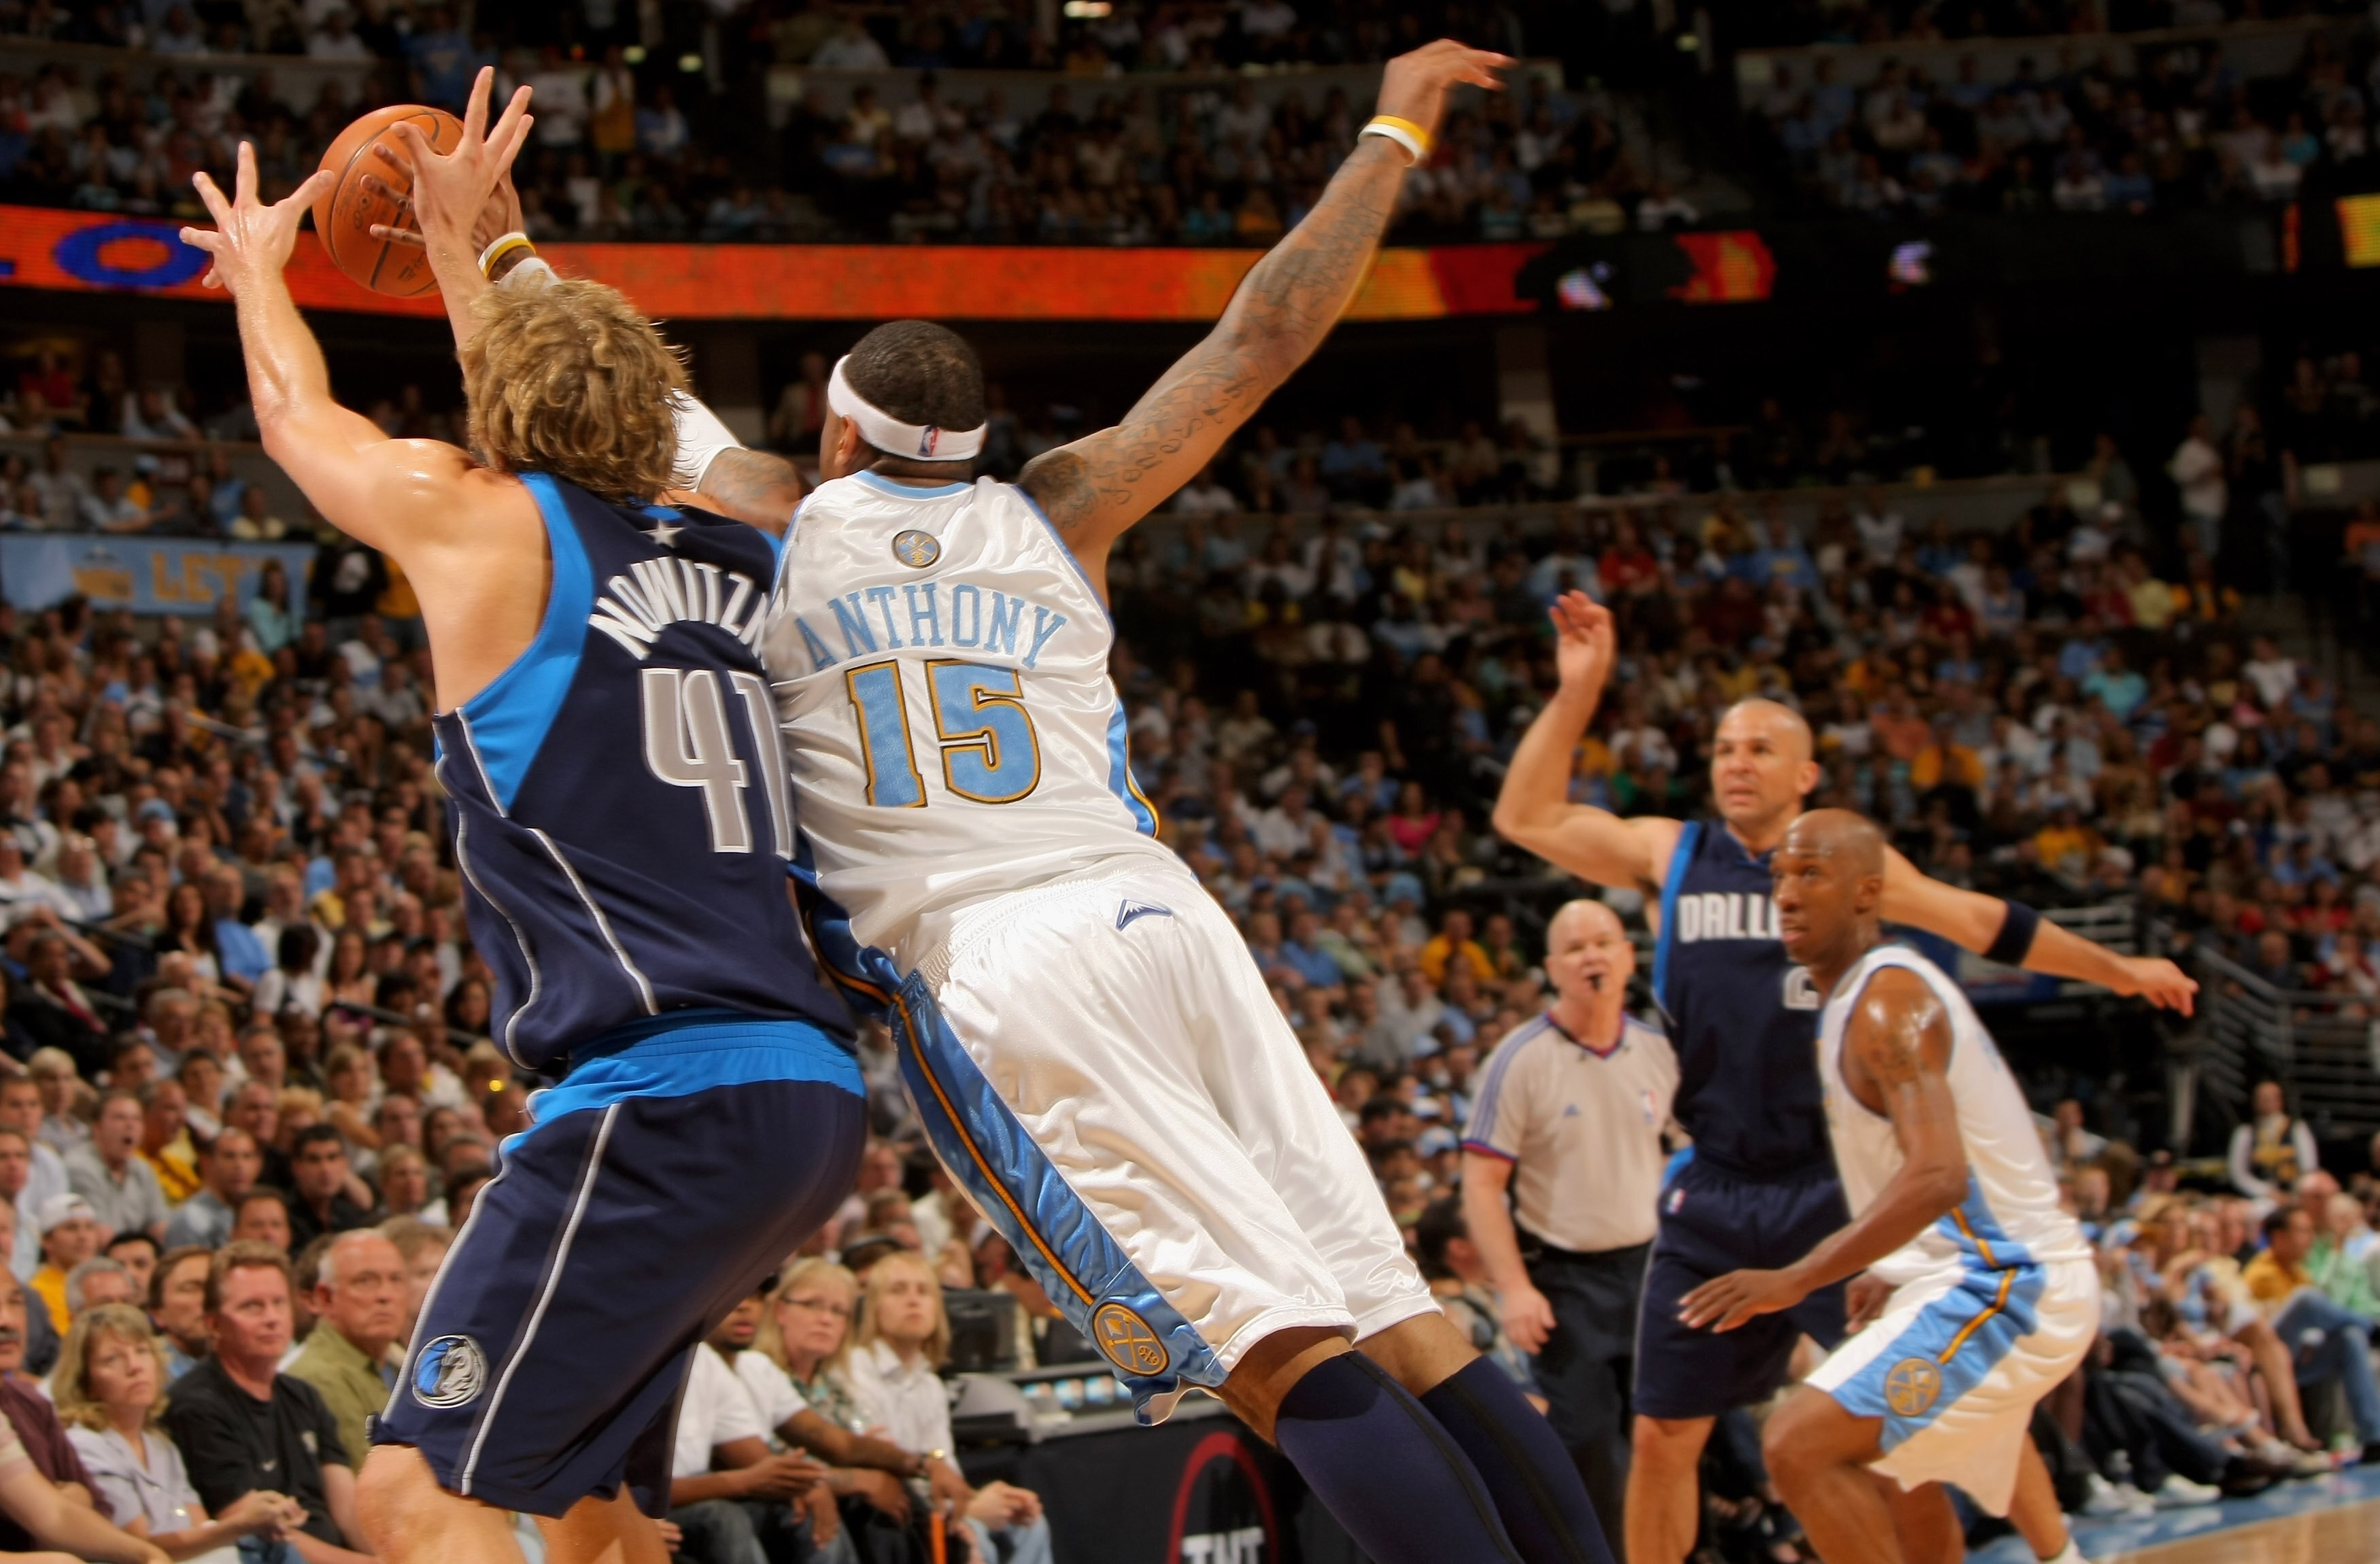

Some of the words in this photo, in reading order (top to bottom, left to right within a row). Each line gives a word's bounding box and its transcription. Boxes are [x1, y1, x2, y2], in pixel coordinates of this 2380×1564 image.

[795, 582, 1068, 672] ANTHONY
[639, 668, 797, 862] 41
[844, 659, 1042, 809] 15
[1677, 892, 1782, 944] DALL
[1180, 1526, 1265, 1564] TNT
